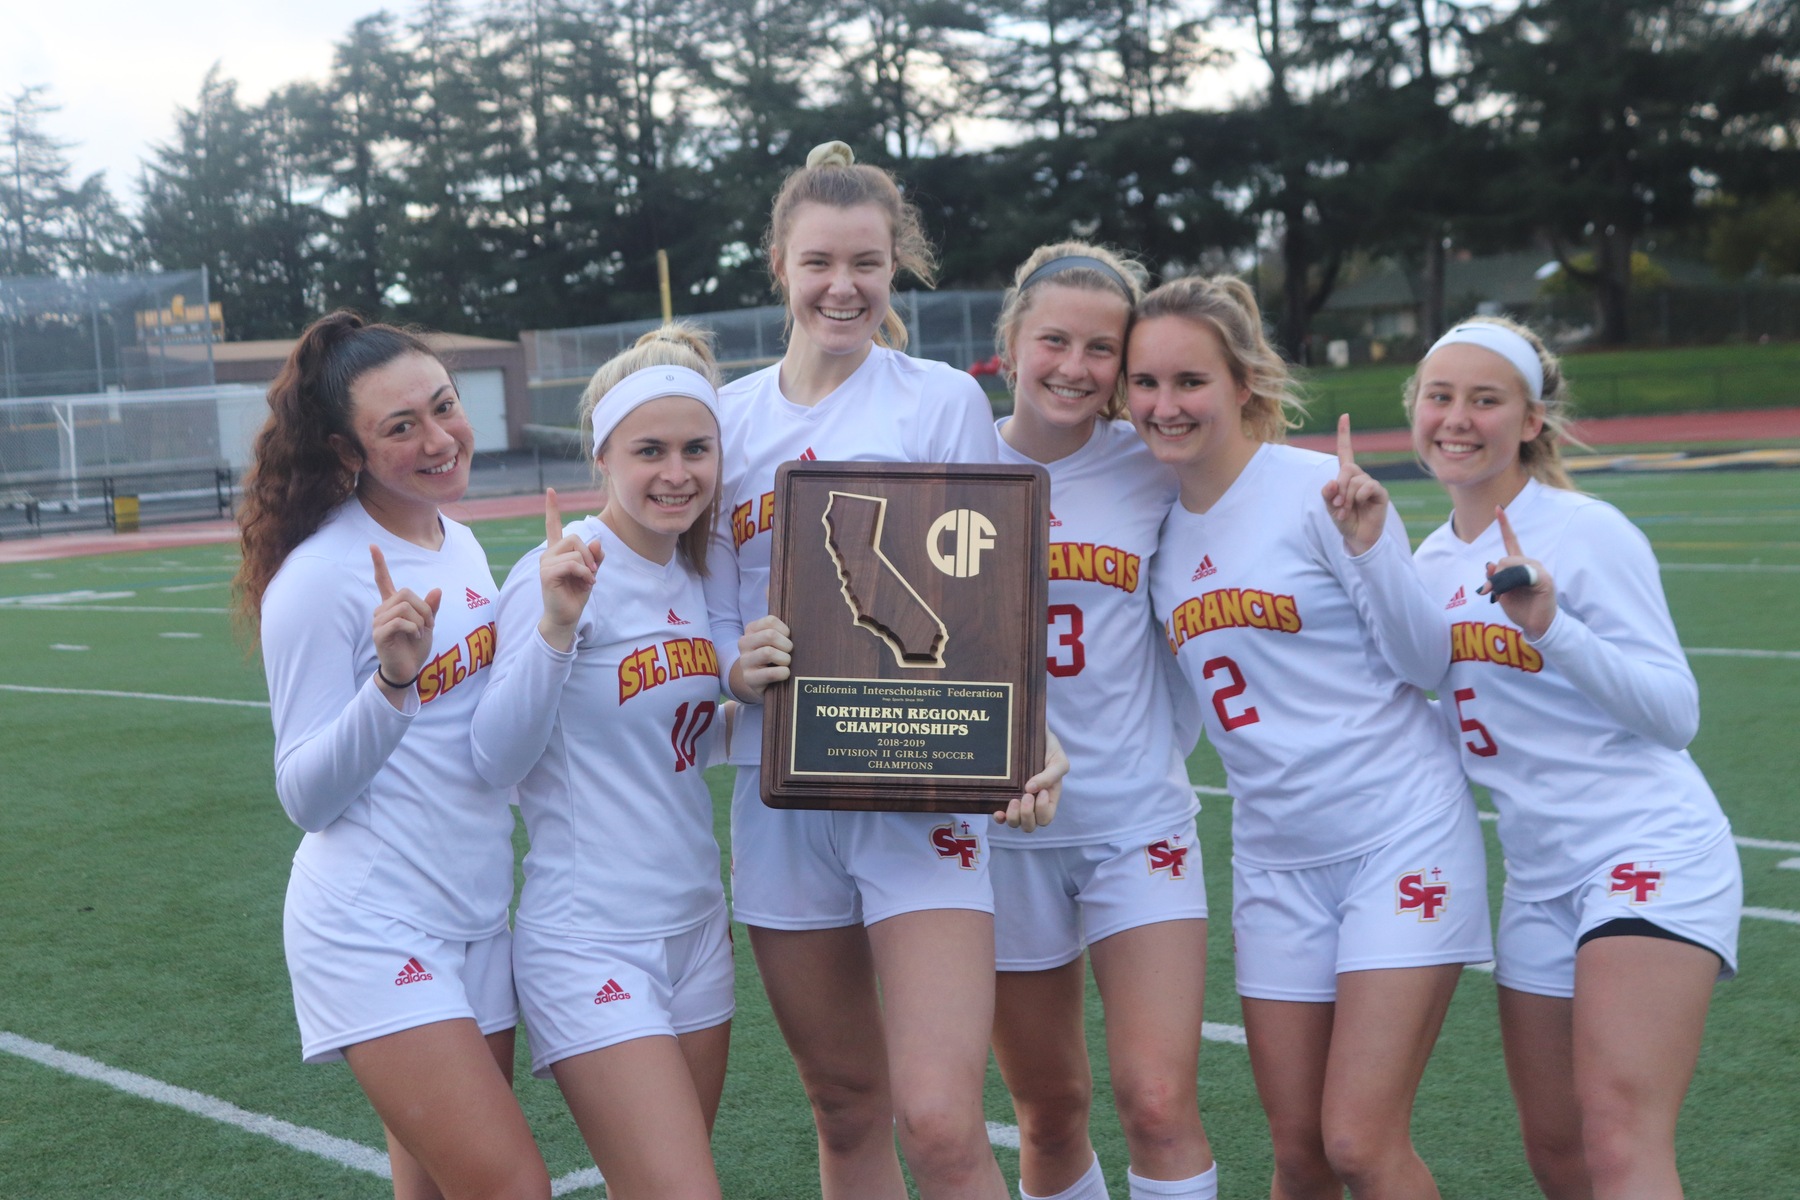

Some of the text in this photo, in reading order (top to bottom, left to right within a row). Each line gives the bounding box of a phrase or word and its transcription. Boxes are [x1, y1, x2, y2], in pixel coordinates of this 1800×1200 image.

[926, 509, 998, 578] CIF
[1048, 541, 1141, 594] ANCIS
[1191, 566, 1217, 582] adidas
[467, 597, 490, 610] adidas
[1172, 587, 1303, 649] FRANCIS
[1046, 603, 1086, 678] 3
[416, 643, 467, 705] ST.
[618, 637, 720, 707] ST. FRAN
[804, 684, 1004, 698] California Interscholastic Federation
[1202, 655, 1261, 732] 2
[816, 705, 990, 721] NORTHERN REGIONAL
[835, 721, 969, 736] CHAMPIONSHIPS
[1454, 687, 1498, 757] 5
[671, 701, 716, 773] 10
[827, 748, 975, 760] DIVISION II GIRLS SOCCER
[877, 738, 926, 747] 2018-2019
[868, 760, 933, 770] CHAMPIONS
[929, 822, 981, 871] SF
[1144, 838, 1189, 881] SF
[1395, 867, 1450, 923] SF
[1607, 861, 1665, 906] SF
[394, 971, 433, 986] adidas
[594, 990, 631, 1005] adidas
